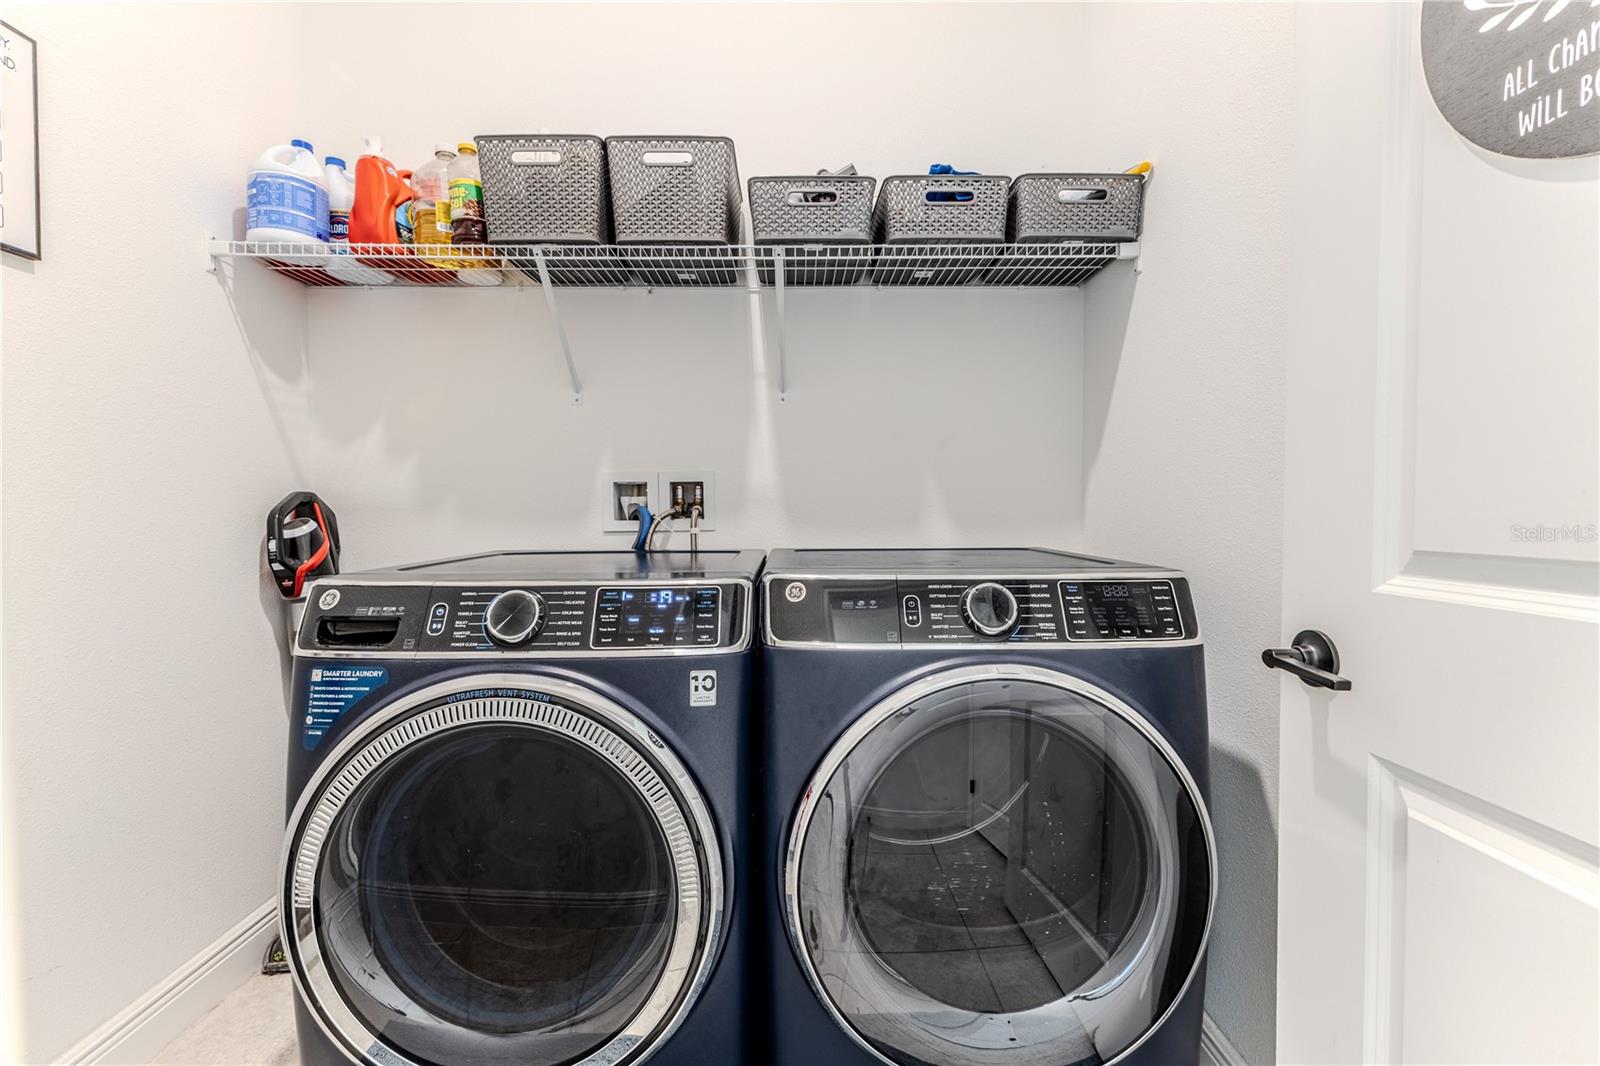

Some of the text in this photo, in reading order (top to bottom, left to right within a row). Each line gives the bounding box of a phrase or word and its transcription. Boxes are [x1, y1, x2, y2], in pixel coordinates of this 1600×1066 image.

[0, 35, 10, 51] Y.
[1503, 59, 1539, 102] ALL
[1518, 88, 1568, 137] WiLL
[330, 223, 349, 234] LORO
[691, 674, 716, 693] 10
[447, 689, 551, 703] ULTRAFRESH VENT SYSTEM
